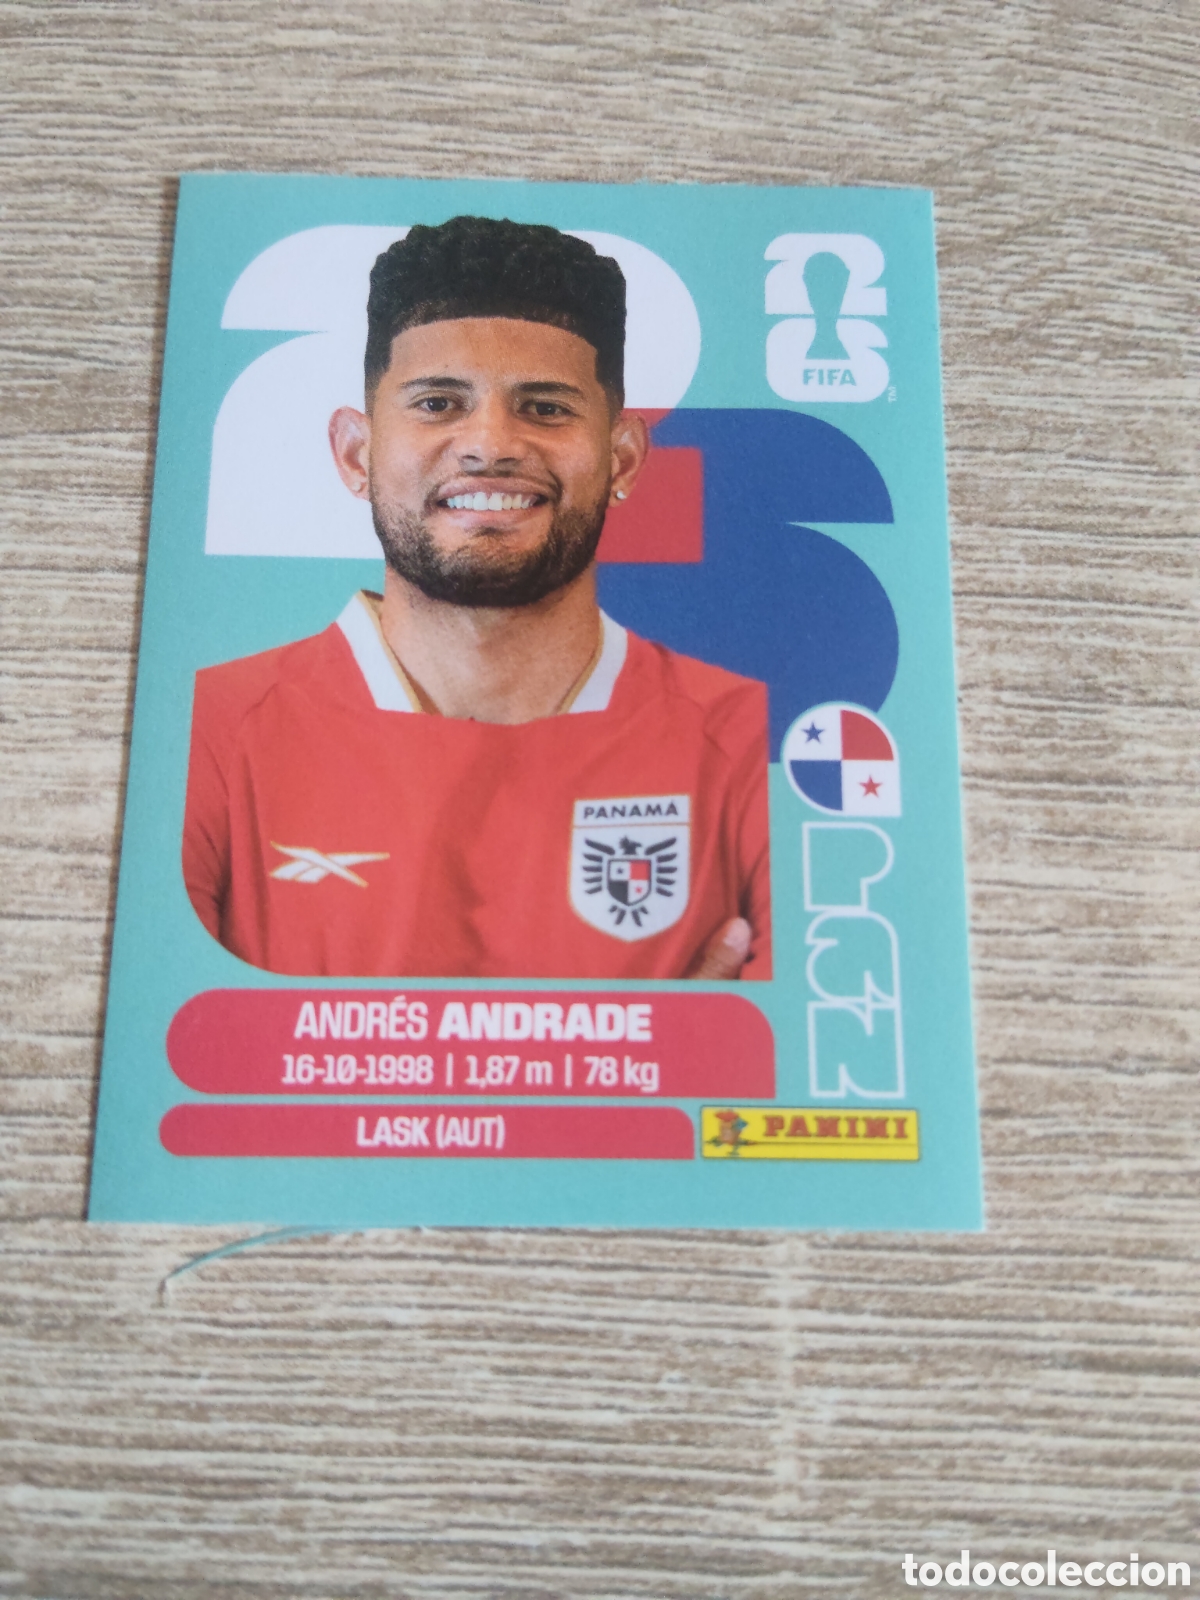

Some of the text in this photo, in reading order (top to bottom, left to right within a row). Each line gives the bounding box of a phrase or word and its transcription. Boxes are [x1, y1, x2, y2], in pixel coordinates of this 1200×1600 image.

[802, 368, 857, 386] FIFA
[294, 995, 652, 1041] ANDRÉS ANDRADE
[282, 1054, 434, 1084] 16-10-1998
[465, 1054, 520, 1088] 1,87
[525, 1059, 553, 1085] m
[583, 1056, 619, 1085] 78
[623, 1055, 659, 1092] kg
[356, 1114, 505, 1149] LASK (AUT)
[763, 1115, 908, 1139] PANINI
